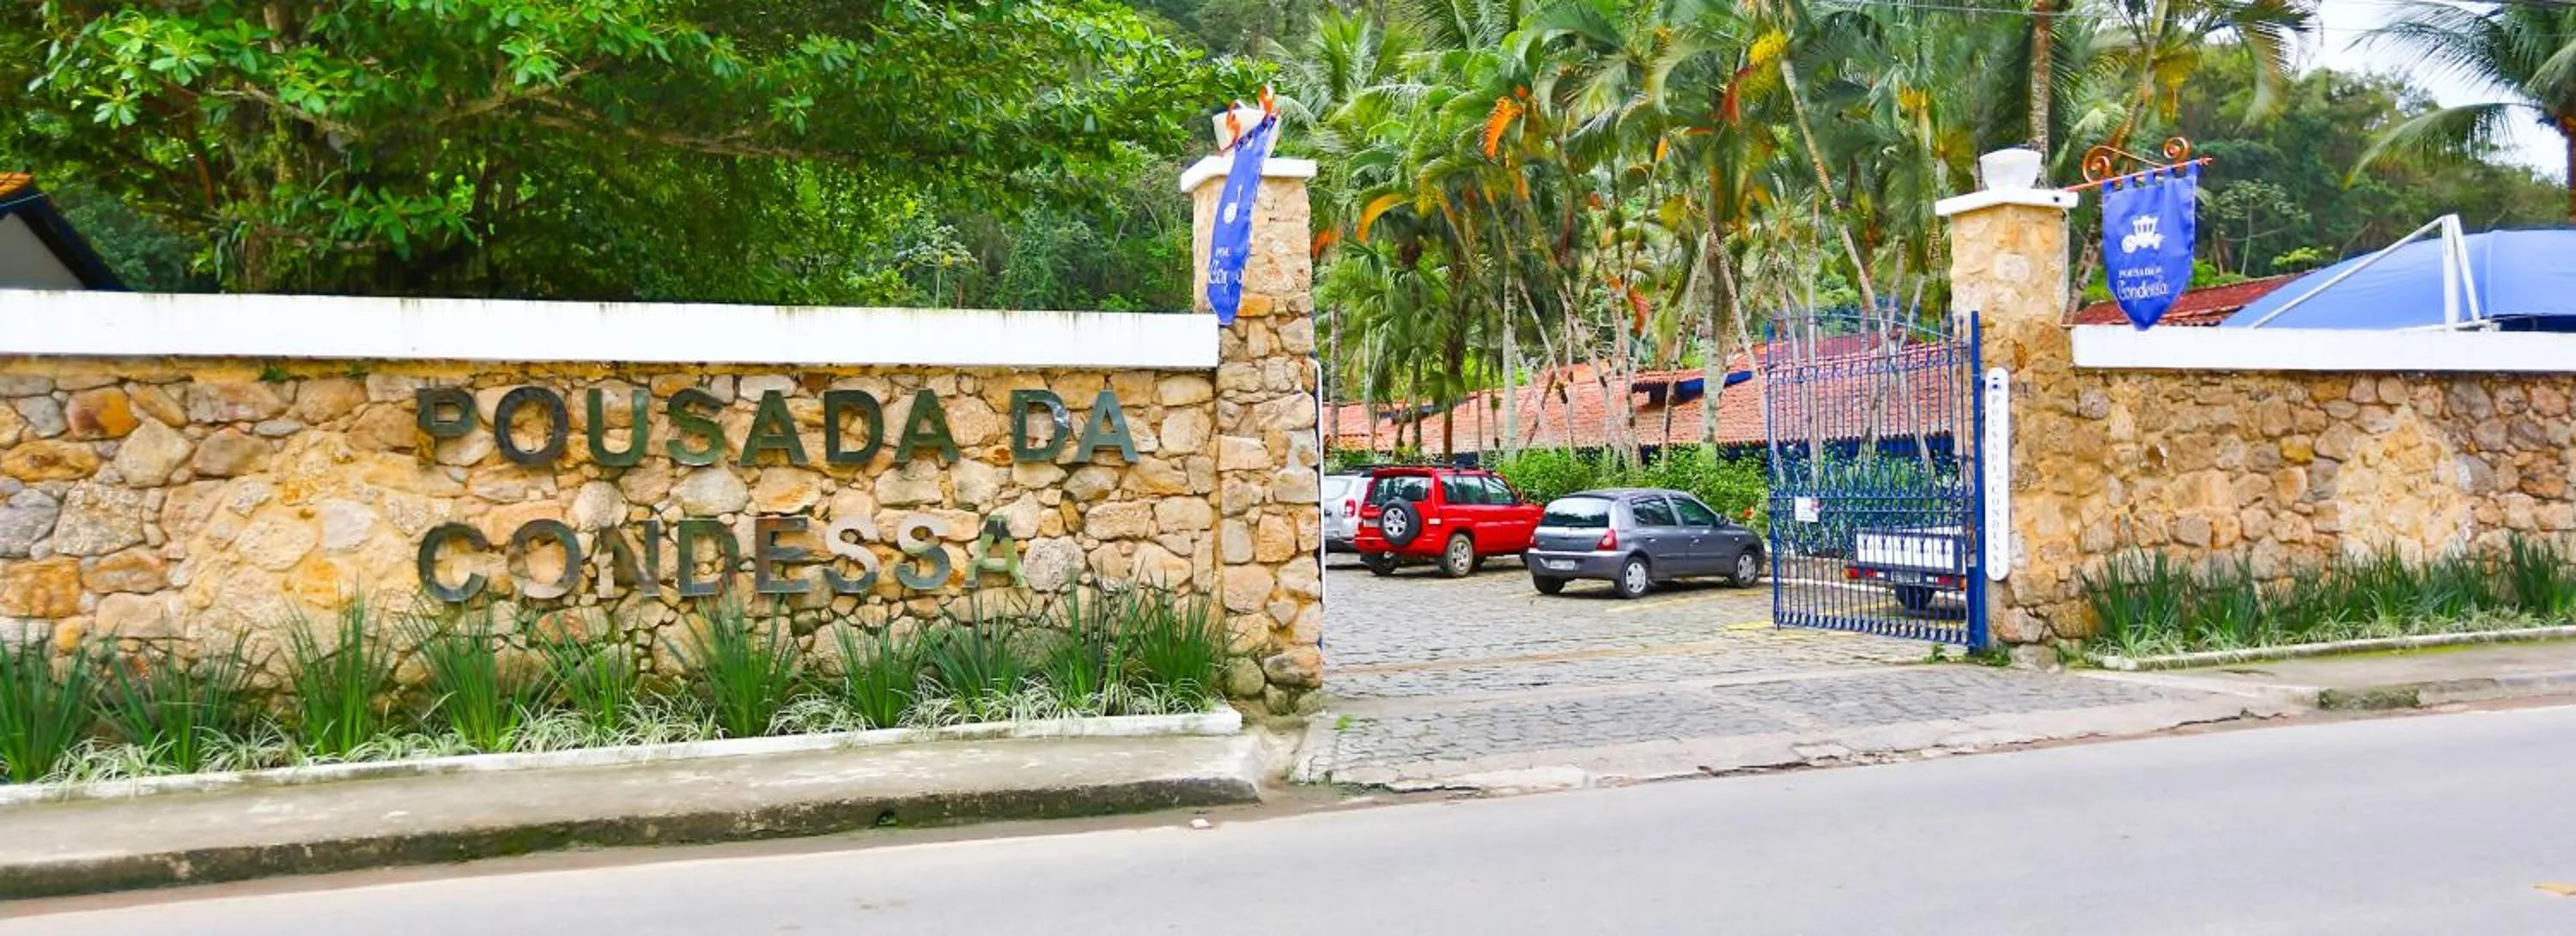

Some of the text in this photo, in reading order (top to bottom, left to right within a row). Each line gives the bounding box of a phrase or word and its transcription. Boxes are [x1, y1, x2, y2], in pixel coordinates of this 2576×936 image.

[415, 386, 1140, 469] POUSADA DA
[416, 515, 1024, 603] CONDESSA
